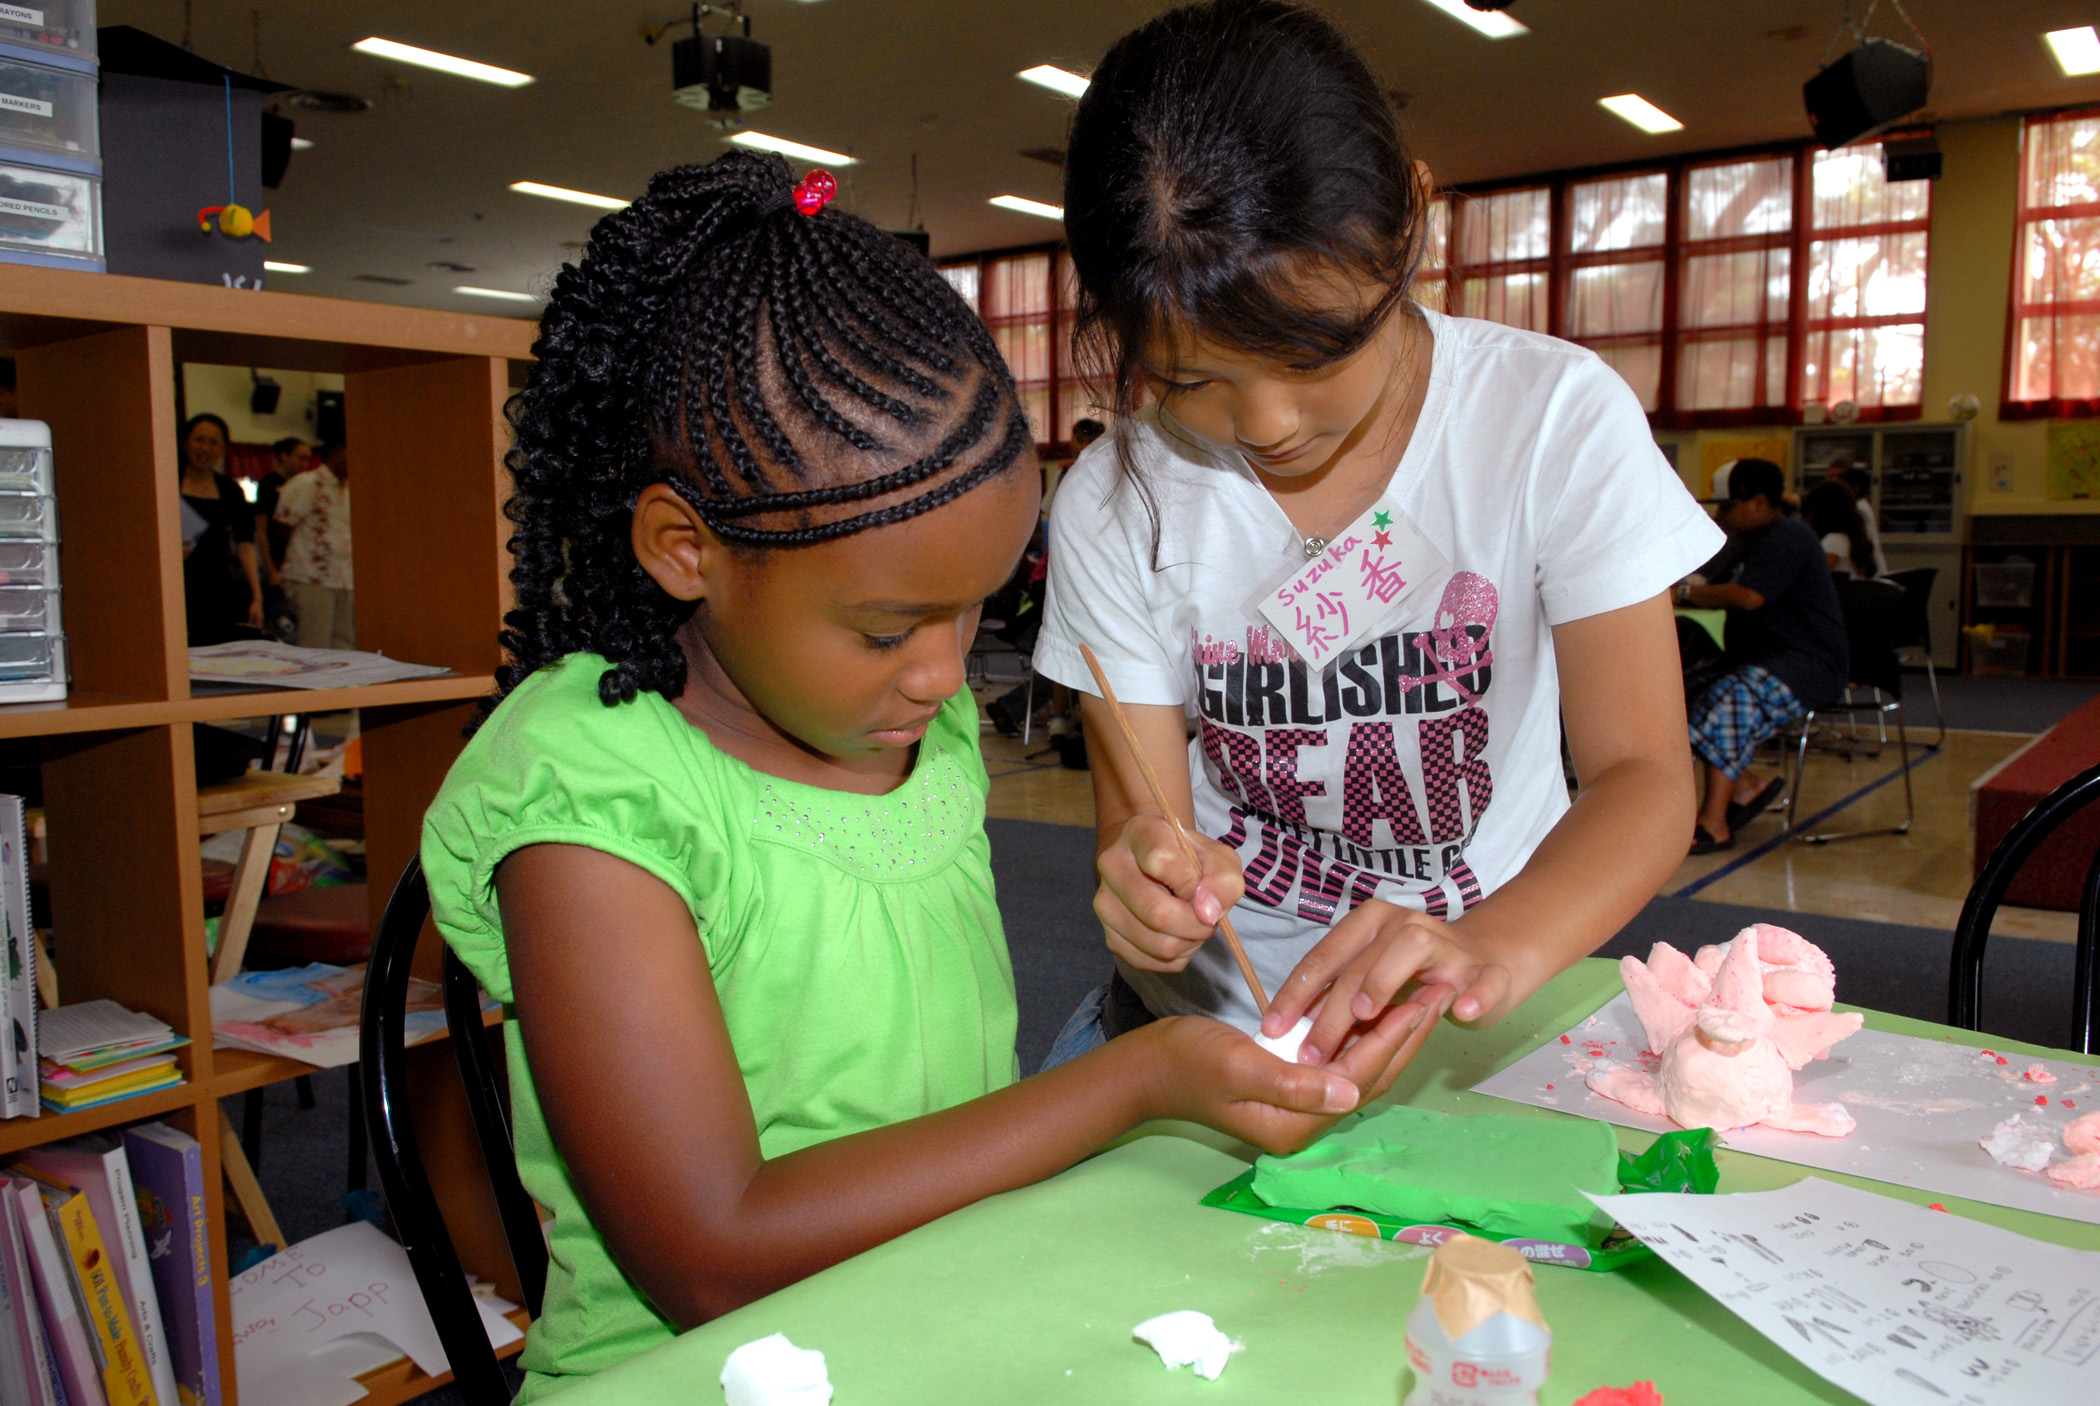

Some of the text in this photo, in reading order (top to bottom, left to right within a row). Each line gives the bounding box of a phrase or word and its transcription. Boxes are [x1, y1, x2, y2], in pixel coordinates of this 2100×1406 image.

[2, 97, 42, 111] MARKERS
[23, 204, 59, 216] PENCILS
[1333, 833, 1433, 882] LITTLE
[191, 1195, 203, 1217] Art
[123, 1213, 138, 1260] Planning
[192, 1218, 208, 1274] Projects
[1510, 1243, 1567, 1259] の混ぜ
[273, 1262, 326, 1289] TO
[139, 1300, 149, 1320] Arts
[146, 1335, 158, 1366] Crafts
